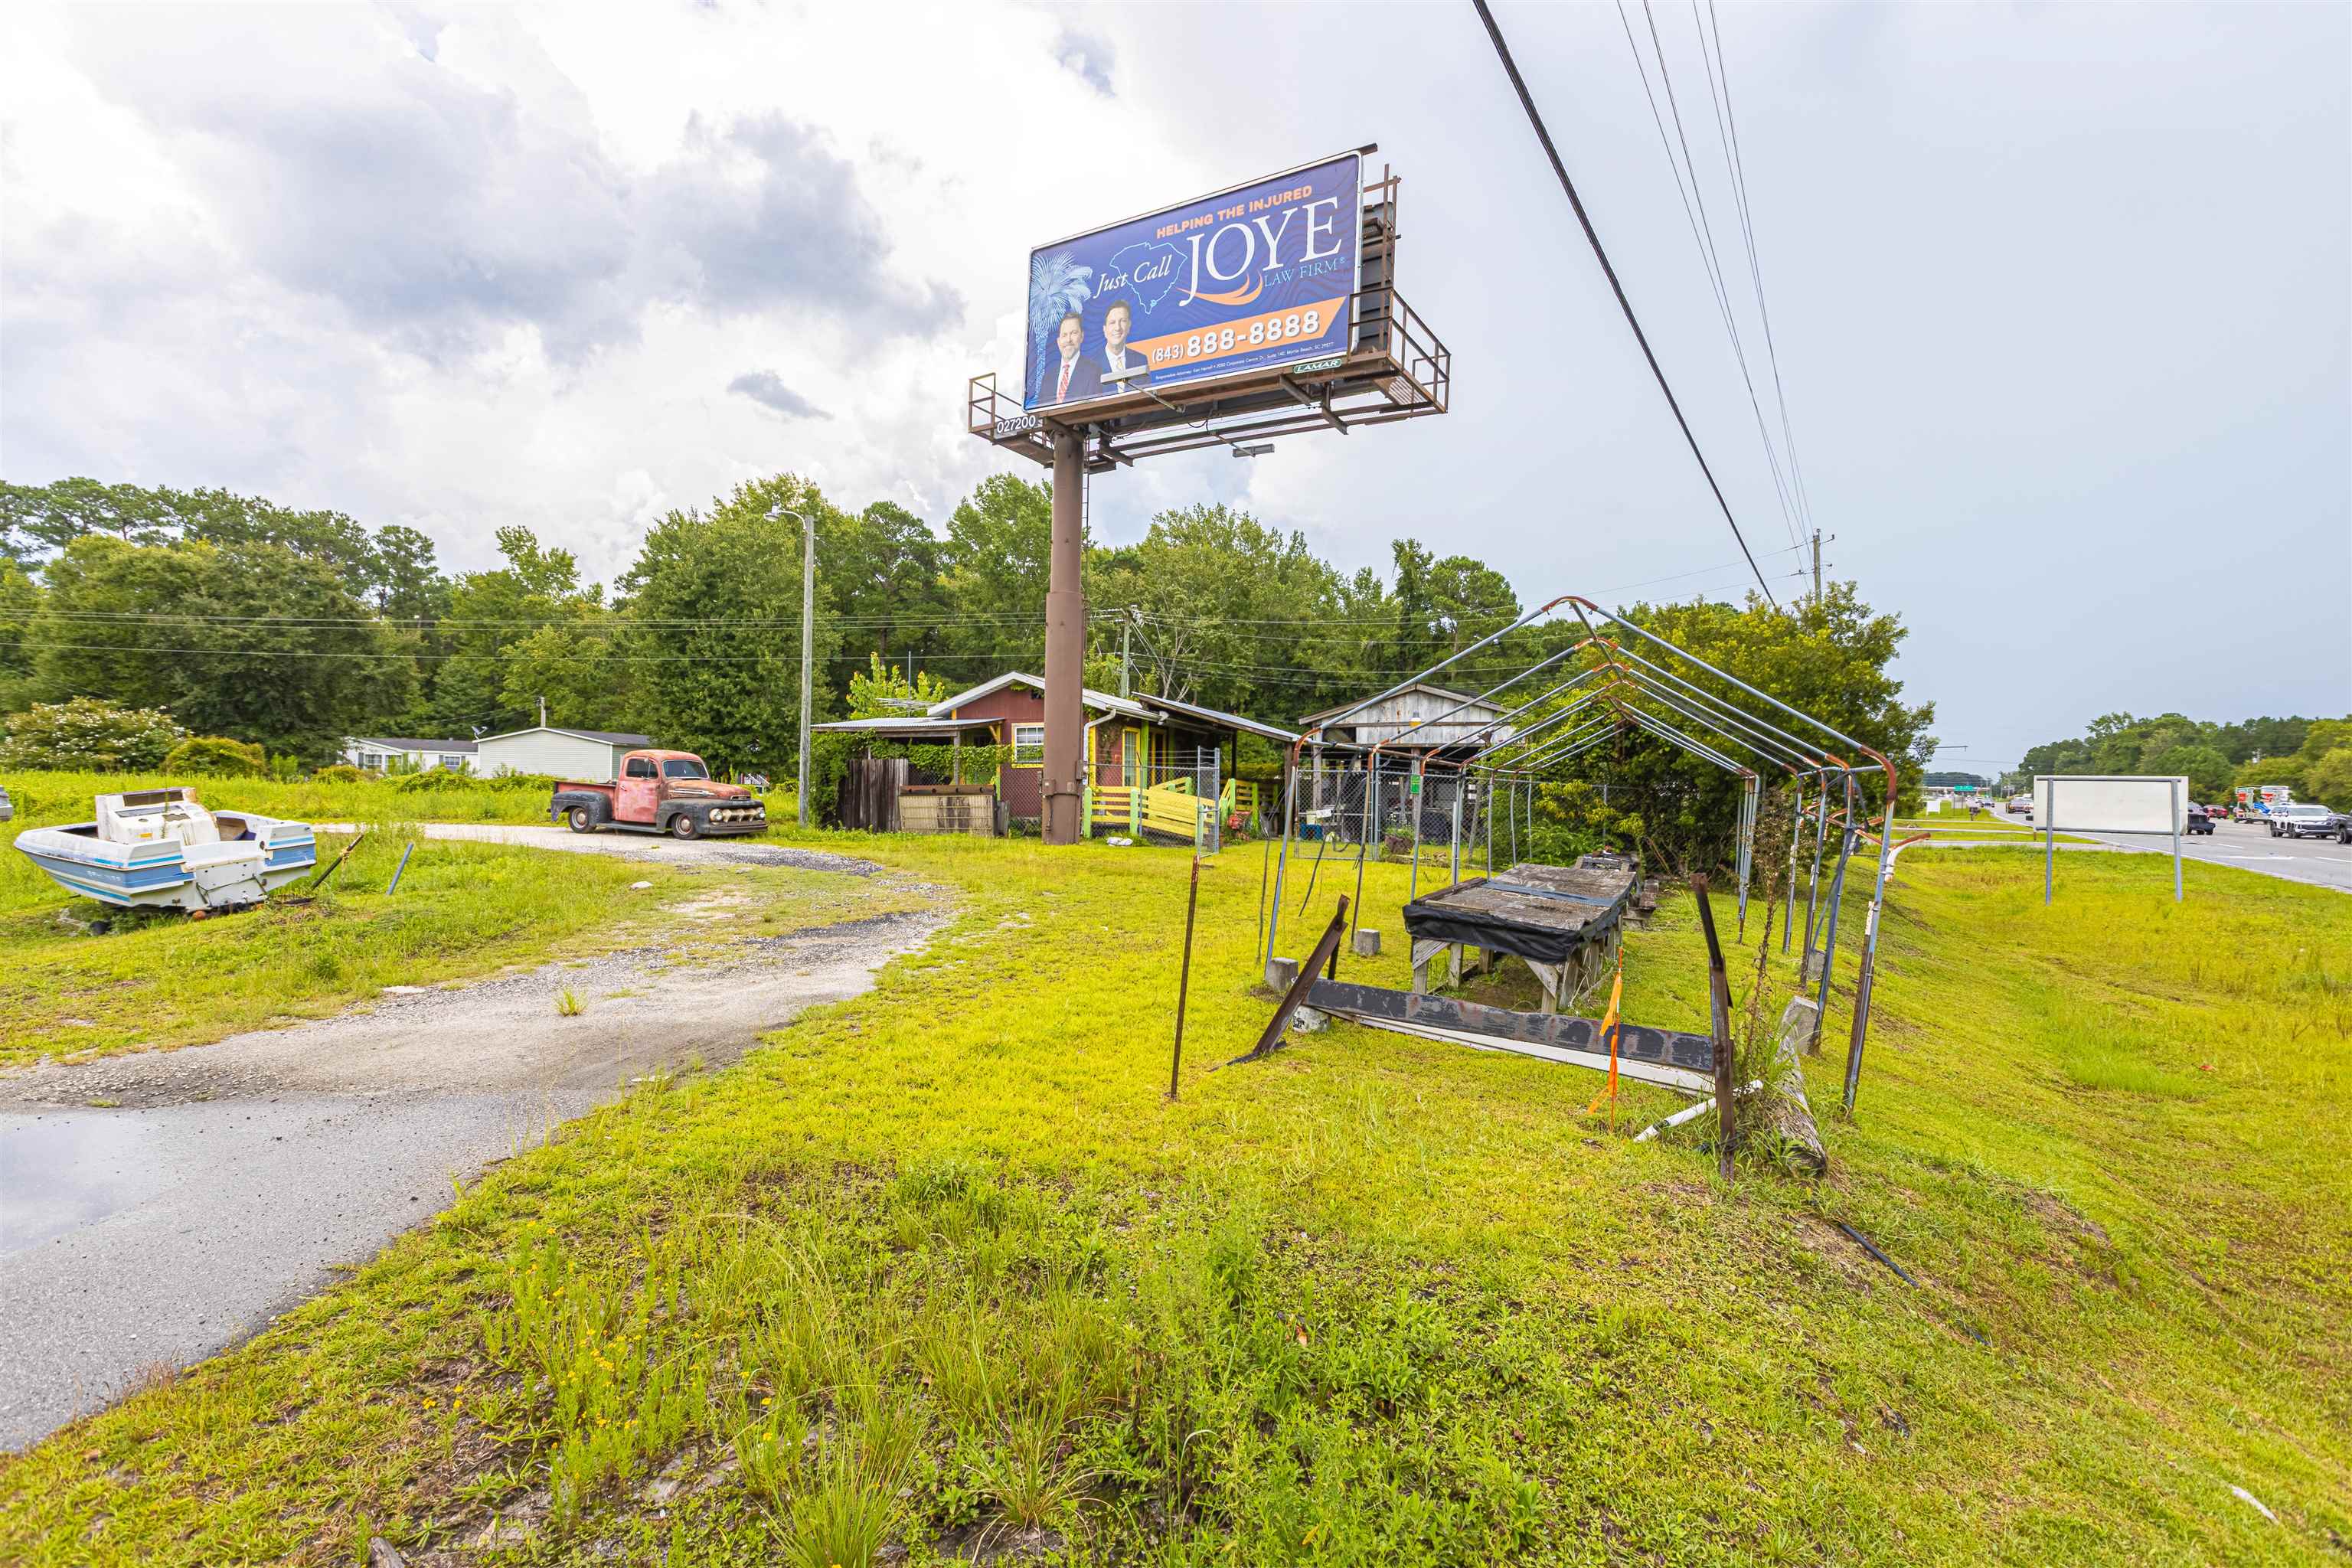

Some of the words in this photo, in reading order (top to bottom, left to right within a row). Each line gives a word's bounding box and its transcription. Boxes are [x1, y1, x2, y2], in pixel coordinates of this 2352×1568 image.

[1156, 213, 1214, 239] HELPING
[1217, 204, 1245, 221] THE
[1249, 185, 1312, 212] INJURED
[1179, 196, 1342, 307] JOYE
[1093, 272, 1129, 299] Just
[1134, 254, 1172, 283] Call
[1264, 269, 1294, 287] LAW
[1152, 344, 1184, 363] (843)
[1187, 310, 1319, 358] 888-8888
[1297, 360, 1338, 371] LAMAR
[997, 415, 1036, 433] 027200
